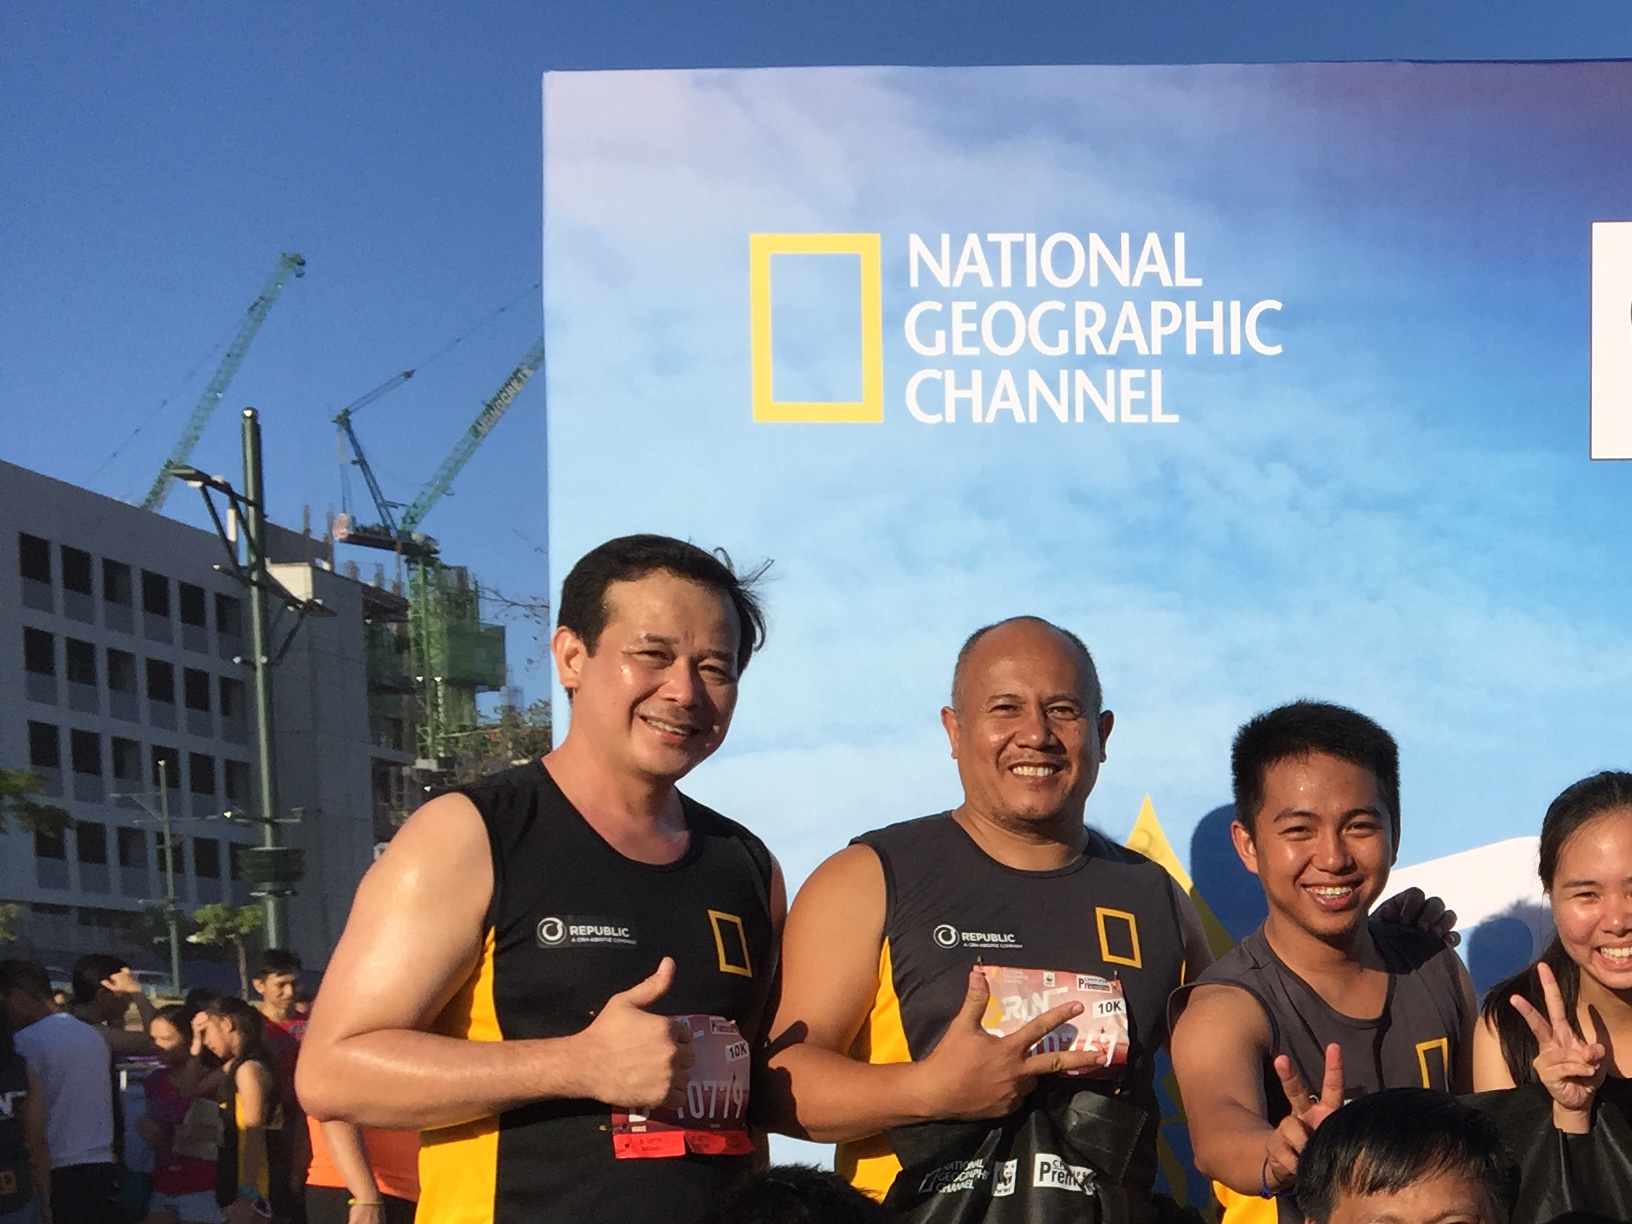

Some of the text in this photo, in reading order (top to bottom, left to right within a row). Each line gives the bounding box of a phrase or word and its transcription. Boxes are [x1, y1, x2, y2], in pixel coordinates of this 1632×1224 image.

[909, 232, 1203, 288] NATIONAL
[904, 300, 1284, 356] GEOGRAPHIC
[905, 369, 1180, 423] CHANNEL
[569, 925, 630, 938] REPUBLIC
[961, 932, 1016, 943] REPUBLIC
[1098, 1001, 1122, 1015] 10K
[728, 1043, 748, 1059] 10K
